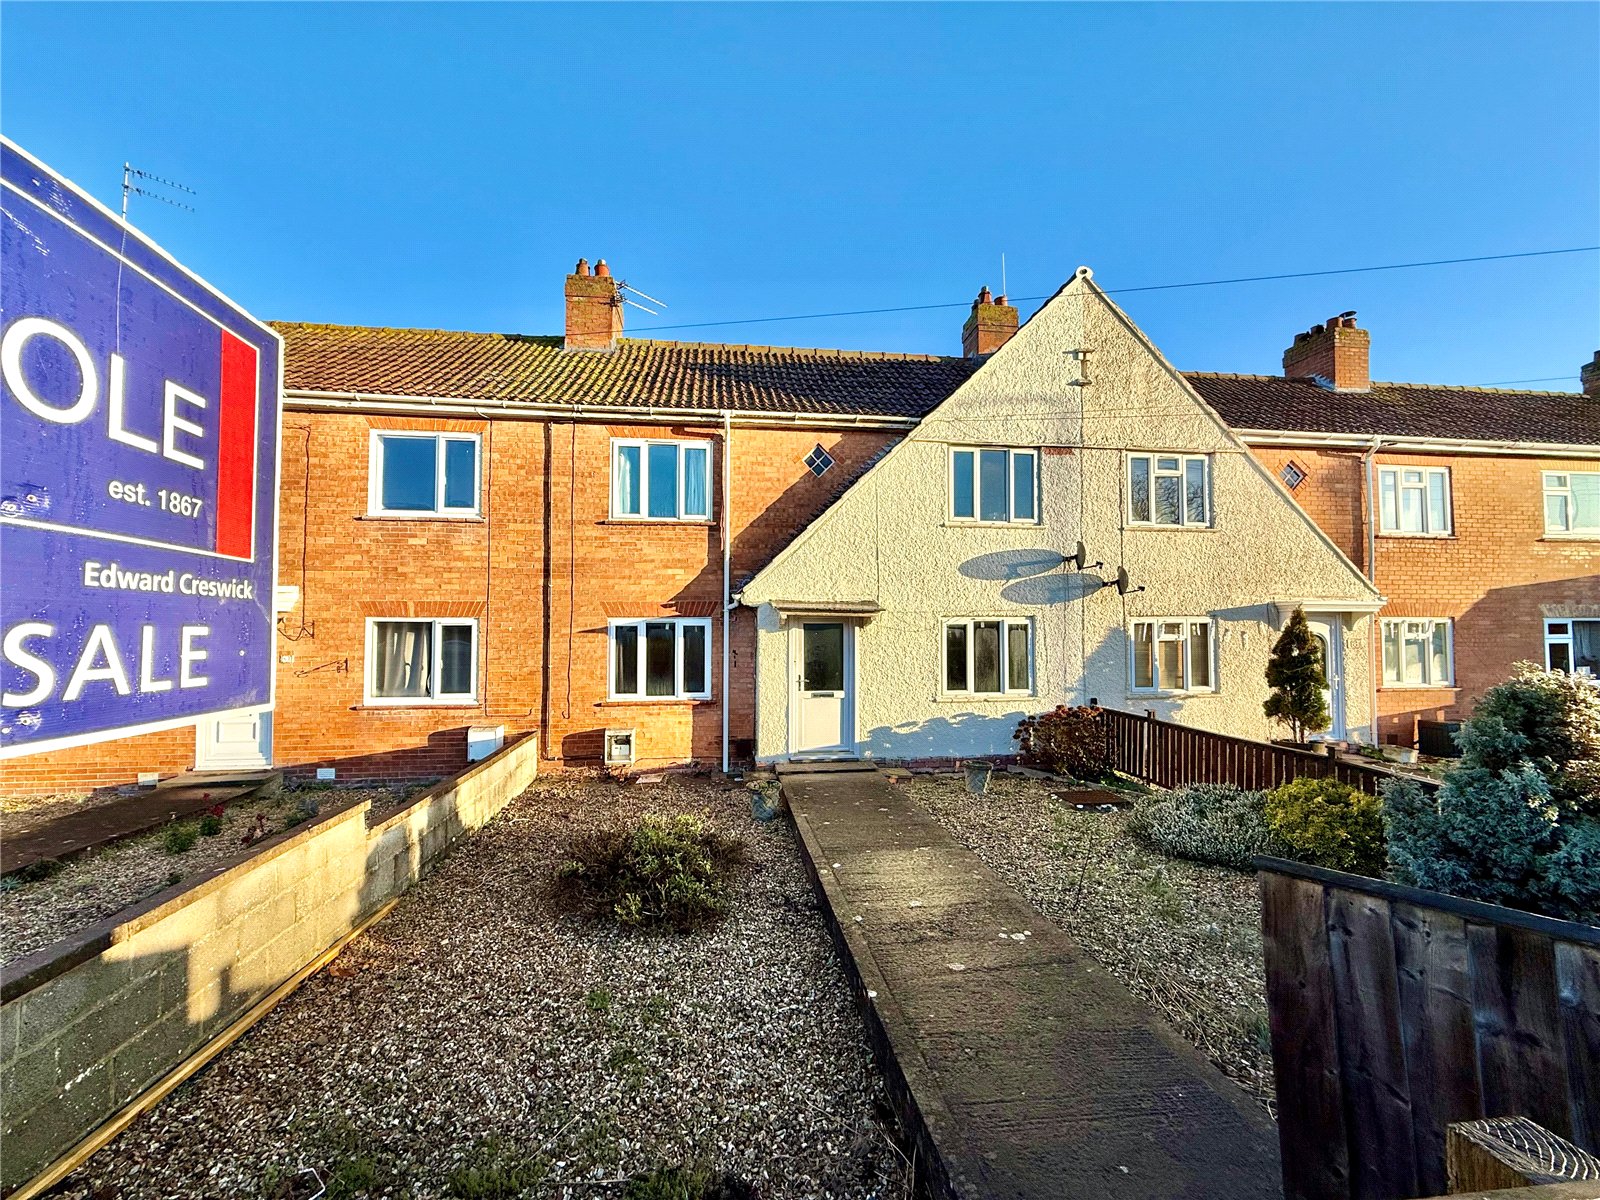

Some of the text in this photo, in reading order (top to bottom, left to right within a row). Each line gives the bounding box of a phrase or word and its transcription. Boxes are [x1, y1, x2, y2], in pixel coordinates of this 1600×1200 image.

[1, 317, 206, 470] OLE
[108, 480, 204, 519] est. 1867
[84, 561, 253, 599] Edward Creswick
[1, 622, 209, 707] SALE
